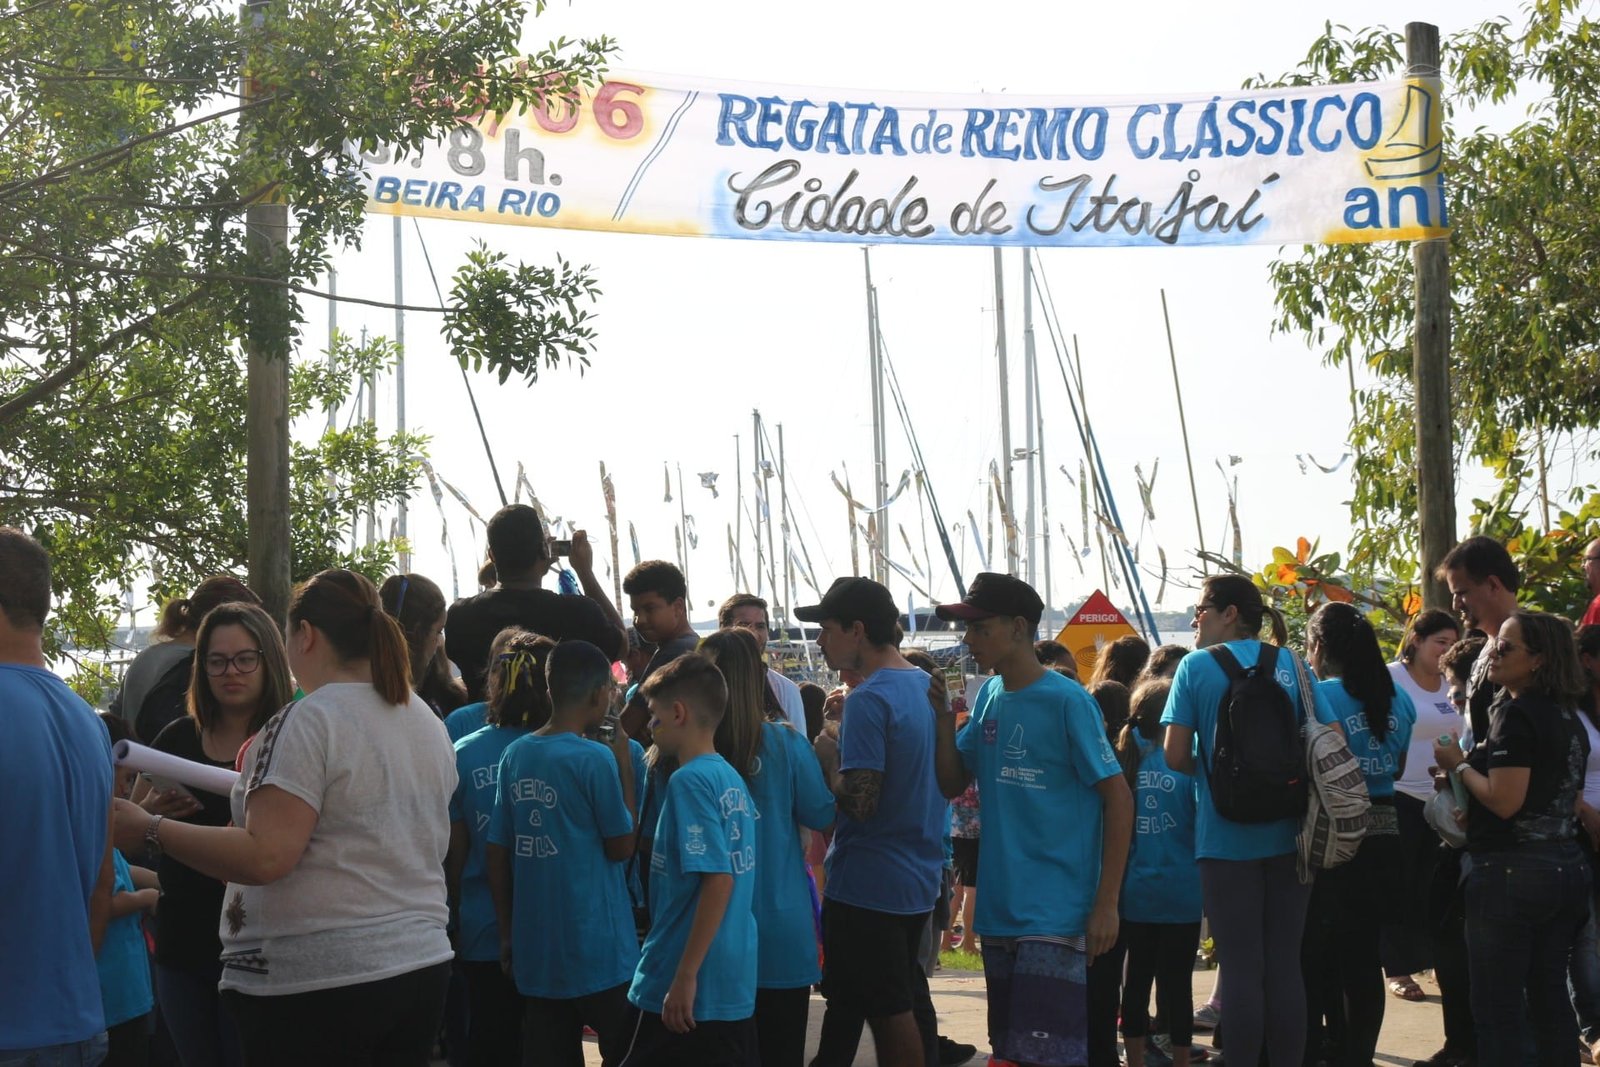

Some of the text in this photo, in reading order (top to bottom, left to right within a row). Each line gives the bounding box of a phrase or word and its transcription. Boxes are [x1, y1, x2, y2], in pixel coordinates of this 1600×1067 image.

[715, 91, 1383, 162] REGATA de REMO CLÁSSICO
[448, 126, 486, 176] 8
[504, 128, 563, 186] h.
[374, 176, 486, 212] BEIRA
[497, 188, 561, 217] RIO
[727, 158, 1280, 245] Cidade de Itajaí
[1079, 613, 1119, 623] PERIGO!
[1345, 711, 1399, 735] REO
[1358, 753, 1393, 775] ELA
[1136, 770, 1176, 793] EMO
[529, 808, 542, 826] &
[1136, 811, 1177, 834] ELA
[515, 834, 559, 857] ELA
